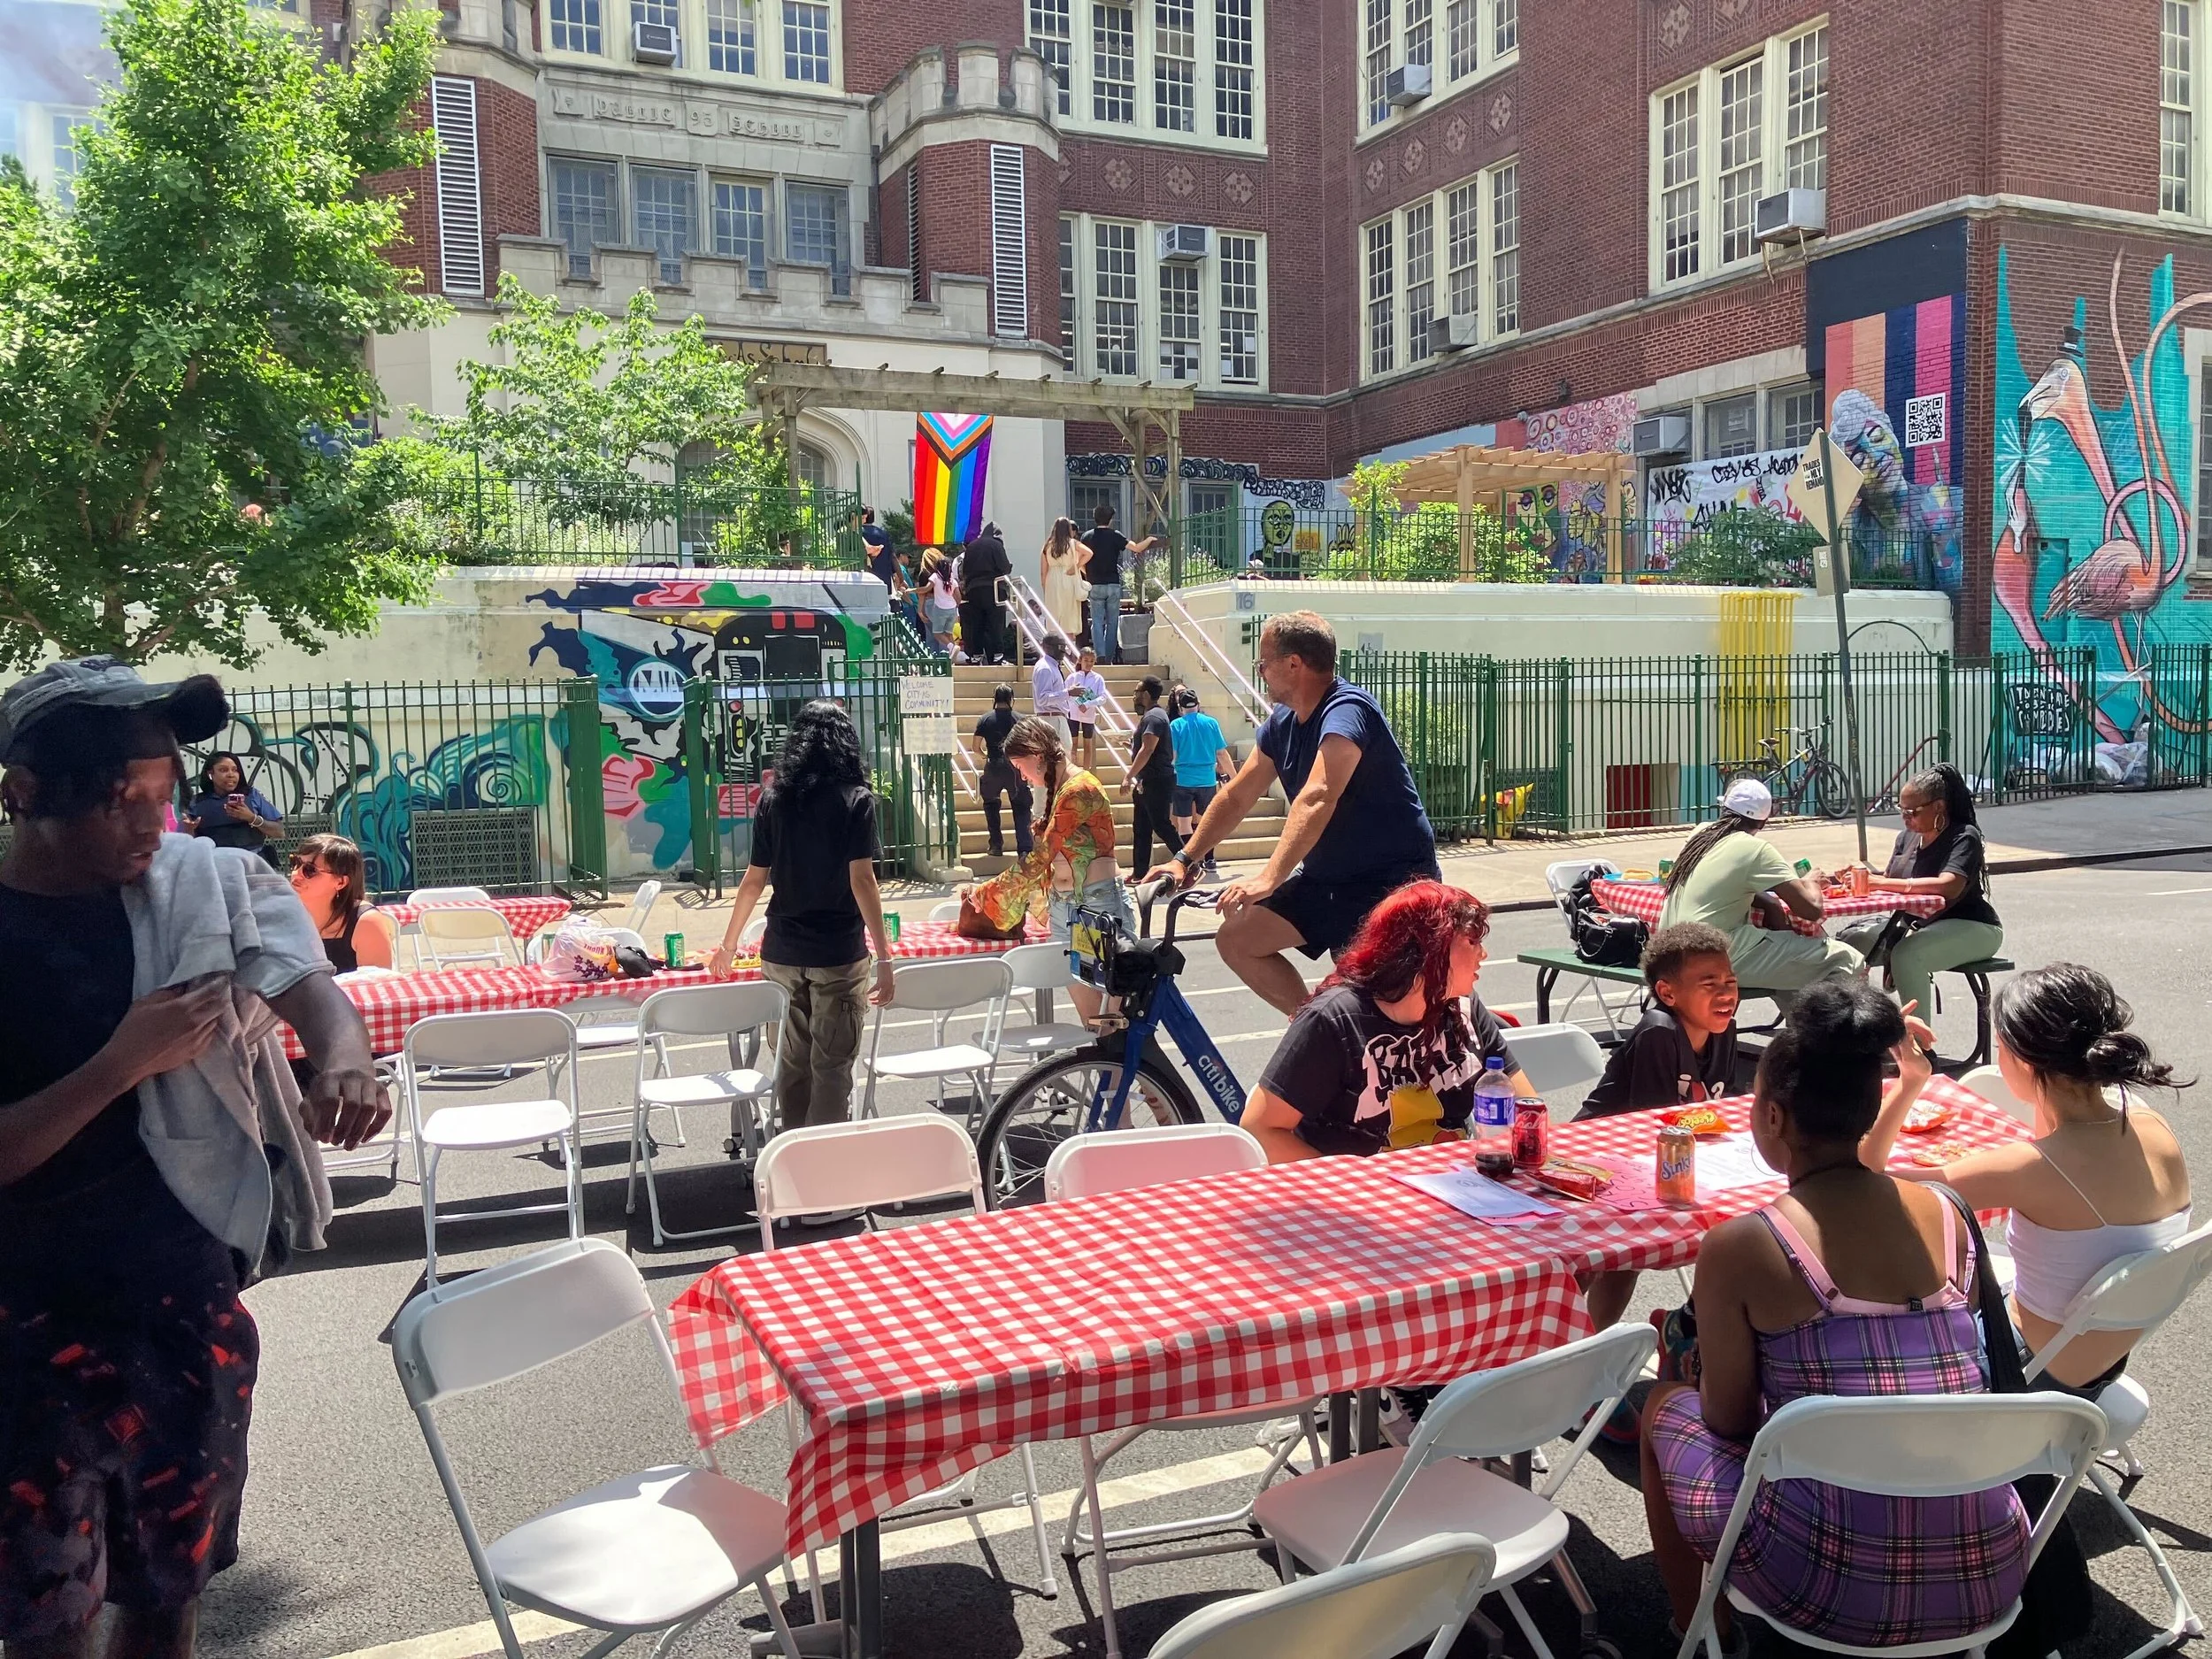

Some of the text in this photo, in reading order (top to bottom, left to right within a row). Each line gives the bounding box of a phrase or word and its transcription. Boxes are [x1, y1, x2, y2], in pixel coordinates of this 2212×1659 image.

[1239, 594, 1253, 610] 16
[901, 679, 934, 690] WELCOME
[1213, 1075, 1240, 1113] bike
